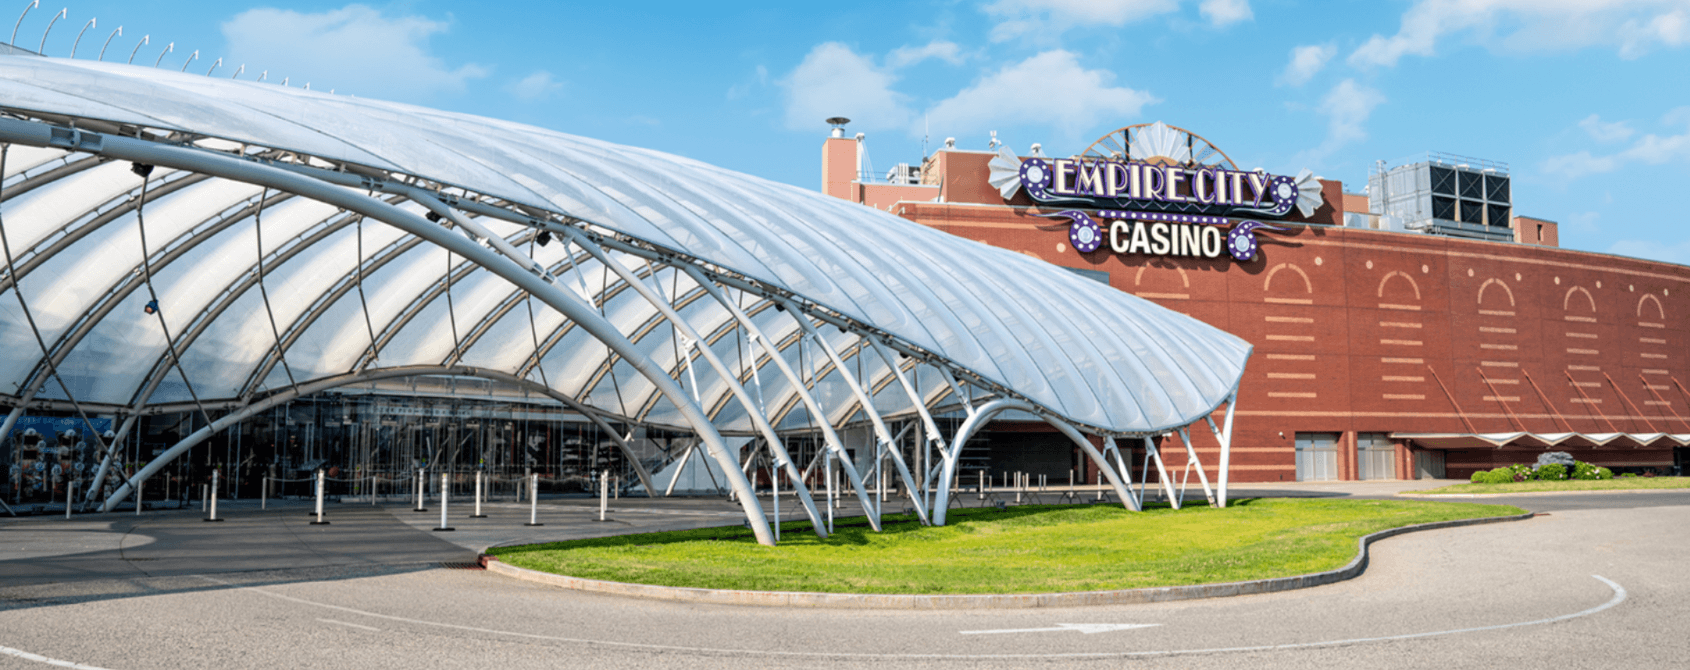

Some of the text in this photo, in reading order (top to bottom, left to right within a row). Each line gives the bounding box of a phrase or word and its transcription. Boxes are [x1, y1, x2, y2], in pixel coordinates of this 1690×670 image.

[1054, 158, 1271, 208] EMPIRE CITY
[1109, 219, 1222, 258] CASINO
